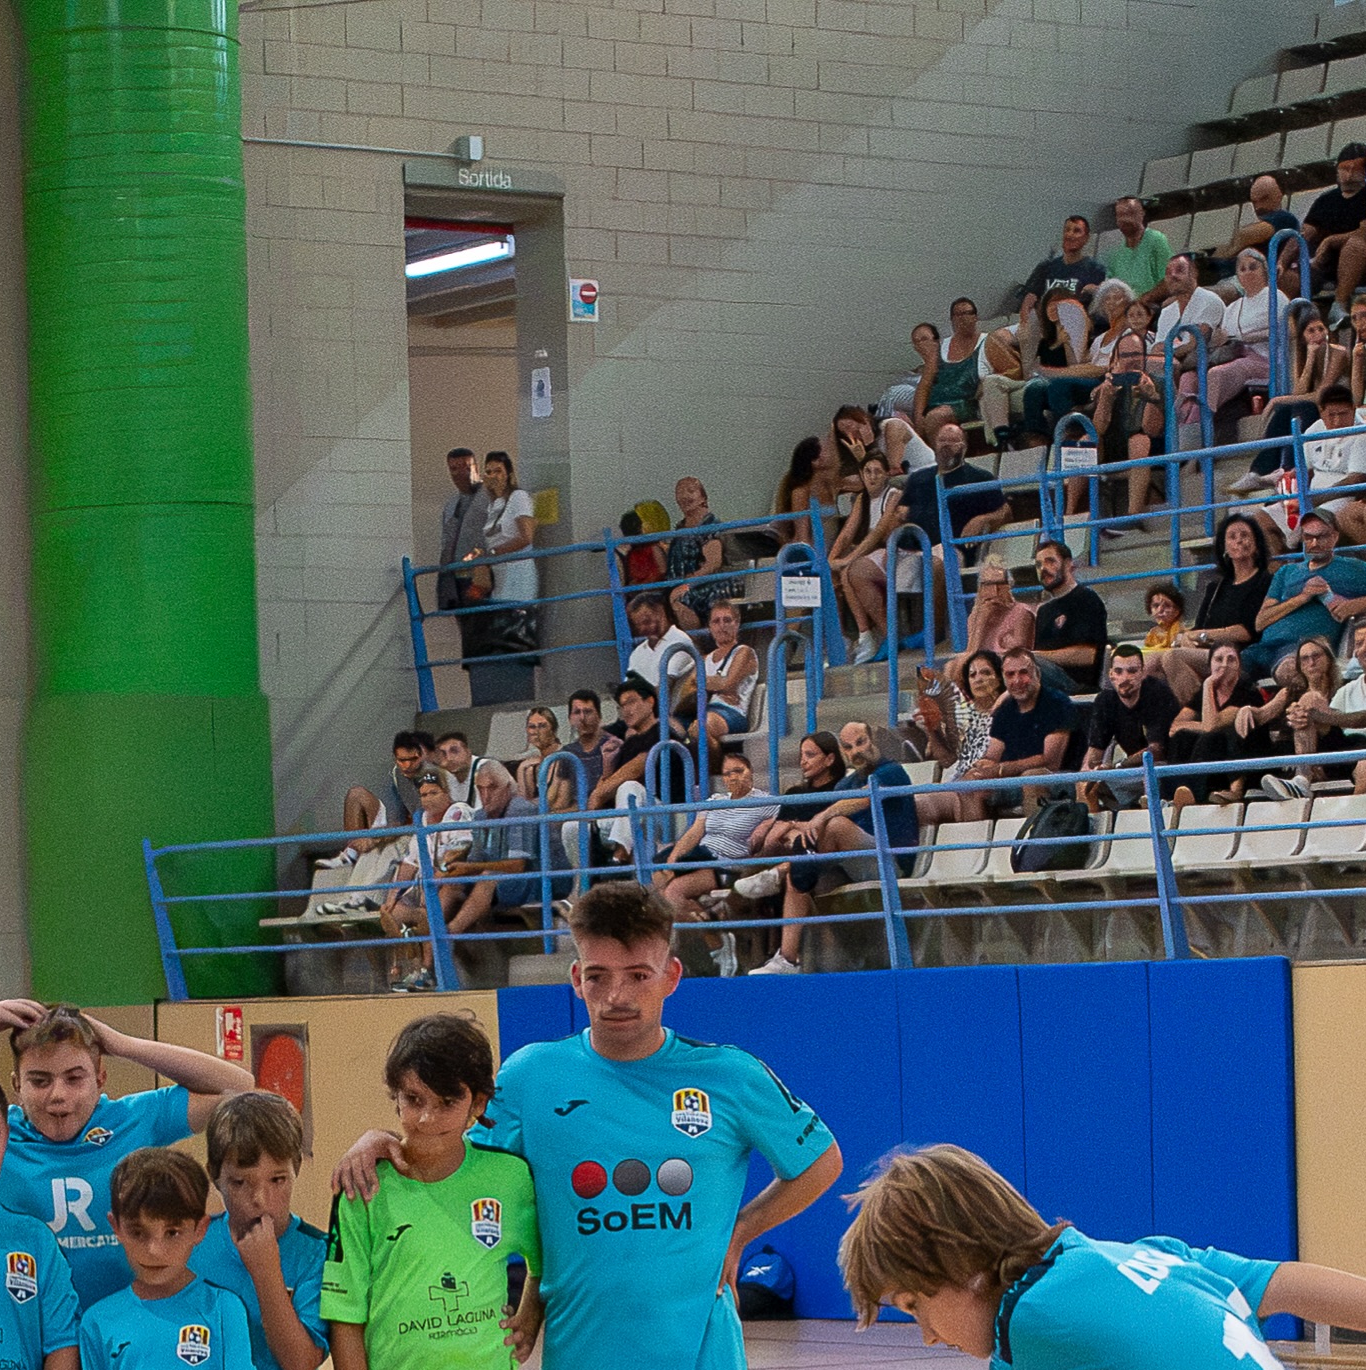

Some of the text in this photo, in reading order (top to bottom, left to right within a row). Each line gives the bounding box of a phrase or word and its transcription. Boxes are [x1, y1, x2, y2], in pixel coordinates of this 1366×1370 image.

[458, 168, 512, 190] Sortida
[577, 1202, 692, 1236] SoEM
[398, 1308, 497, 1335] DAVID LAGUNA
